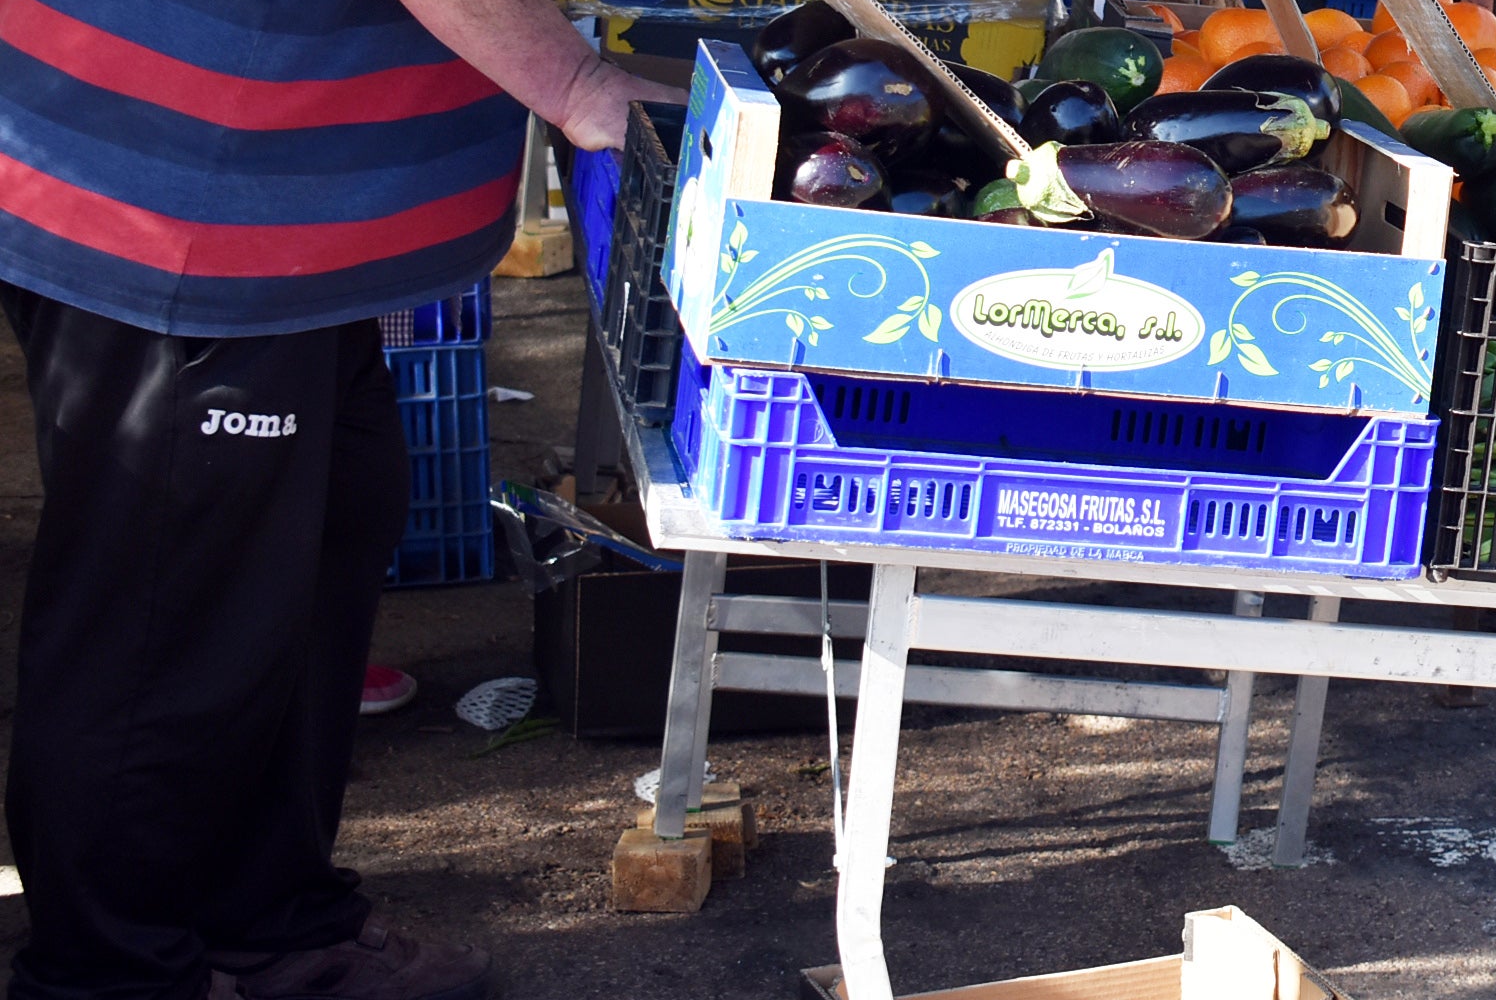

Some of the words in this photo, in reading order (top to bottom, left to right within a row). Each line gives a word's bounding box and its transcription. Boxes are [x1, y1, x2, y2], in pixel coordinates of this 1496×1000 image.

[1042, 347, 1055, 358] DE
[1058, 350, 1095, 362] FRUTAS
[1106, 346, 1165, 362] HORTALIZAS
[200, 409, 297, 437] Joma
[998, 489, 1076, 520] MASEGOSA
[997, 515, 1027, 529] TLF.
[1030, 518, 1080, 533] 872331
[1092, 522, 1165, 538] BOLAÑOS
[1005, 542, 1068, 558] PROPIEDAD
[1070, 546, 1086, 559] DE
[1088, 548, 1103, 560] LA
